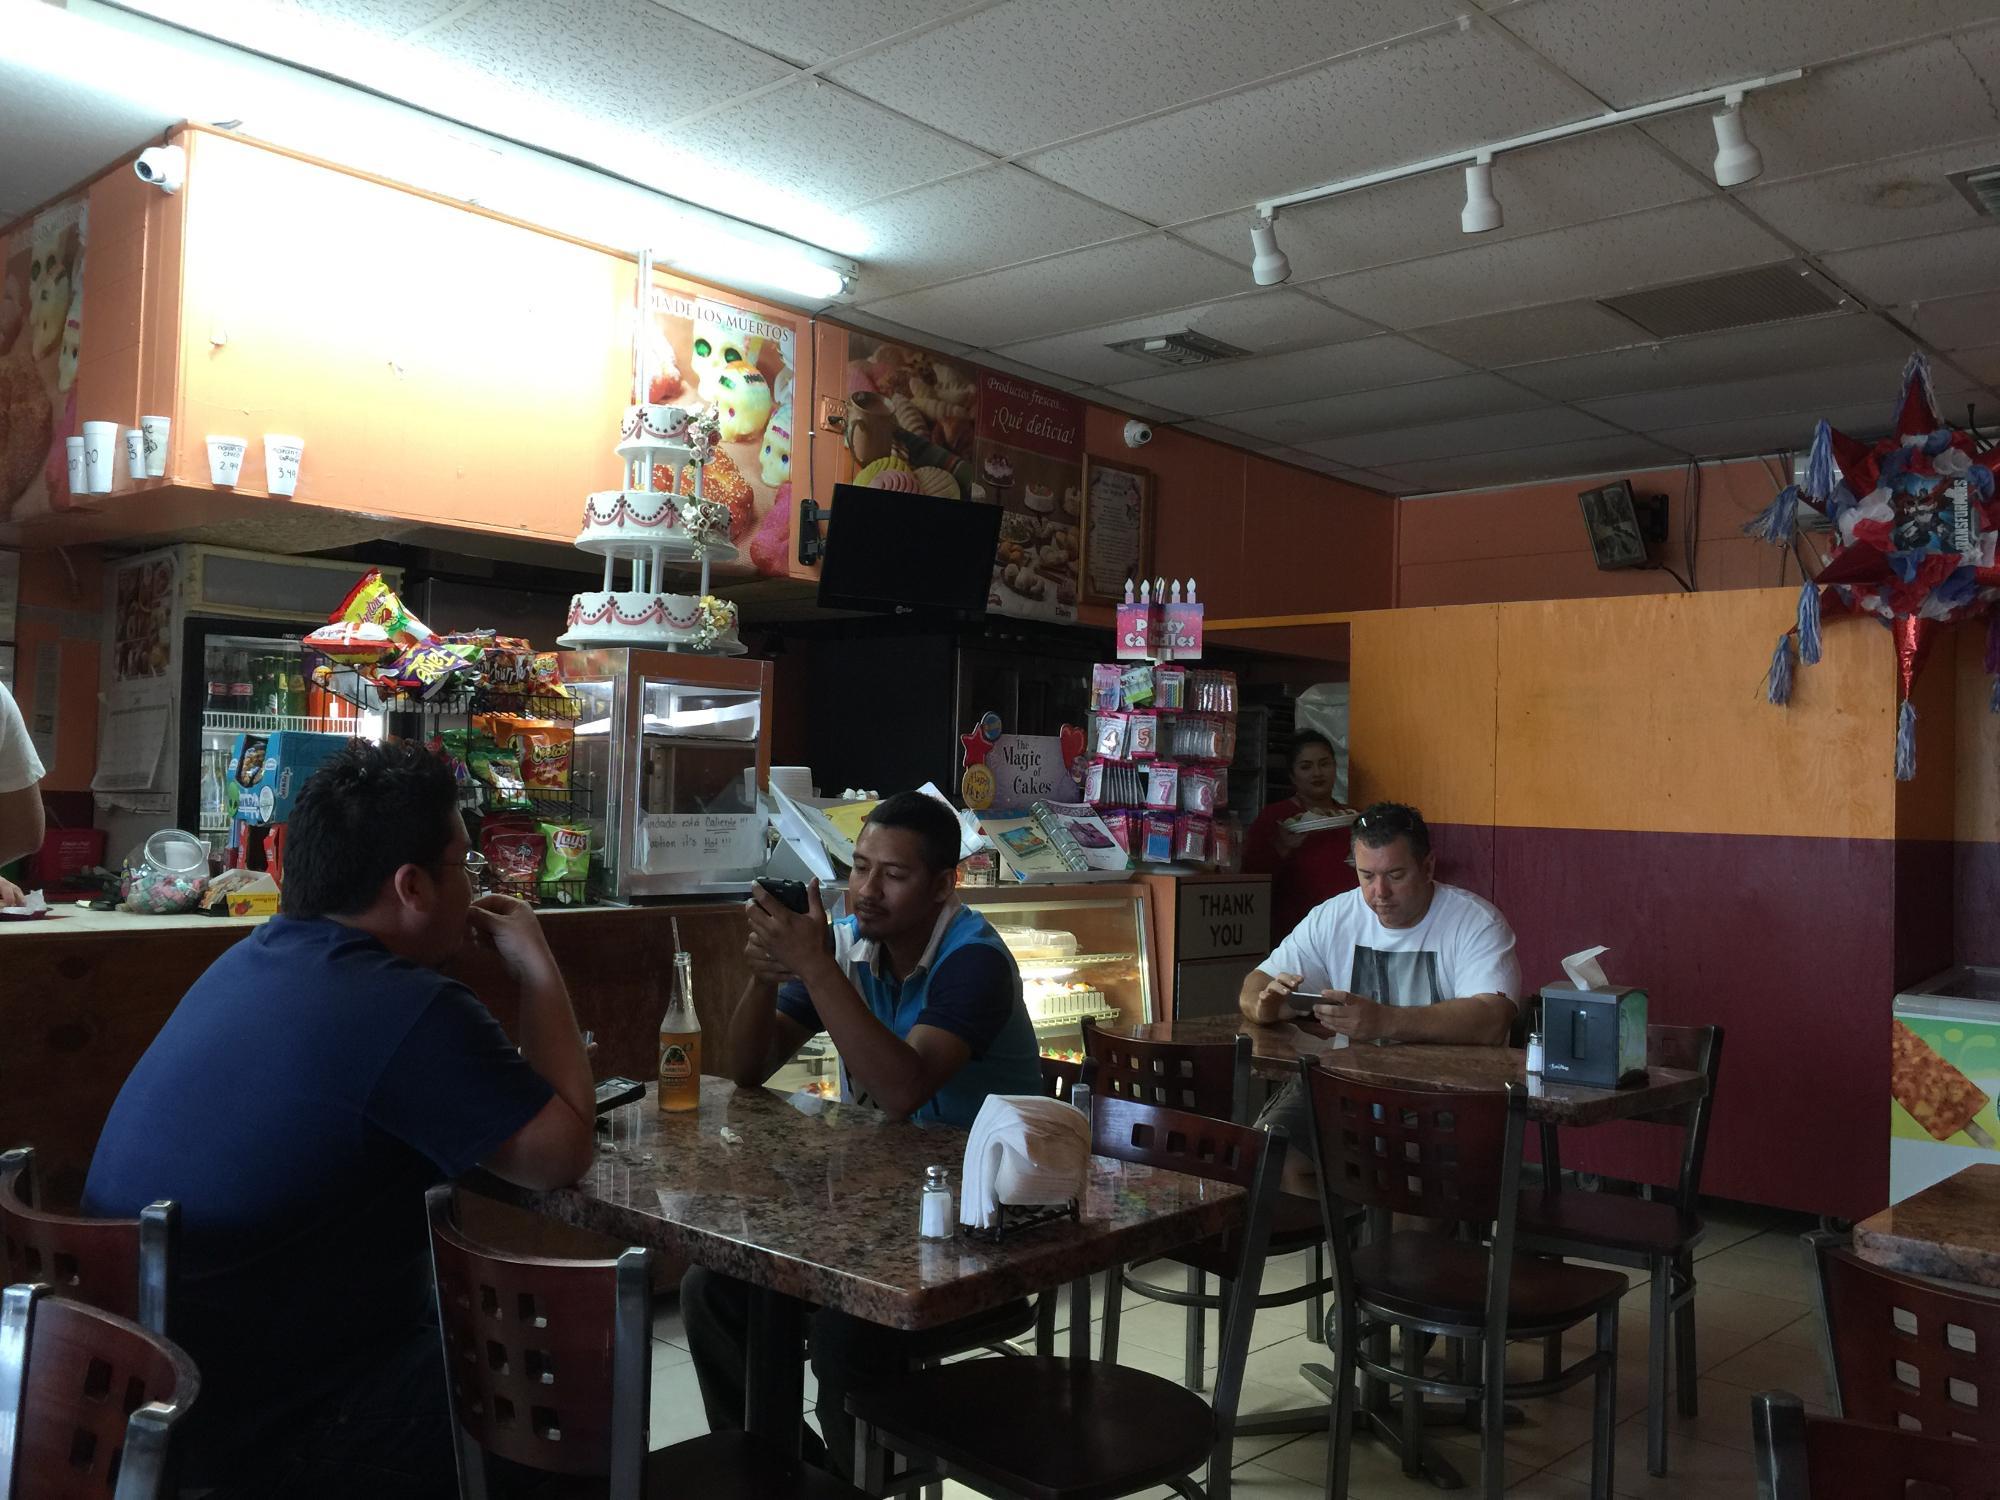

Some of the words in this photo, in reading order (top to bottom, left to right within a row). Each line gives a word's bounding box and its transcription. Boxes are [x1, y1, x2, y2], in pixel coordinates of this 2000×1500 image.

[674, 300, 692, 317] DE
[697, 306, 723, 326] LOS
[726, 313, 790, 343] MUERTOS
[1026, 414, 1076, 445] delicia!
[1135, 618, 1185, 635] Party
[1124, 632, 1196, 648] Candles
[1017, 739, 1030, 750] The
[1137, 727, 1151, 749] 5
[1003, 747, 1042, 771] Magic
[1033, 767, 1042, 777] of
[1013, 776, 1052, 795] Cakes
[1158, 780, 1172, 803] 7
[1199, 893, 1254, 917] THANK
[1210, 924, 1243, 947] YOU
